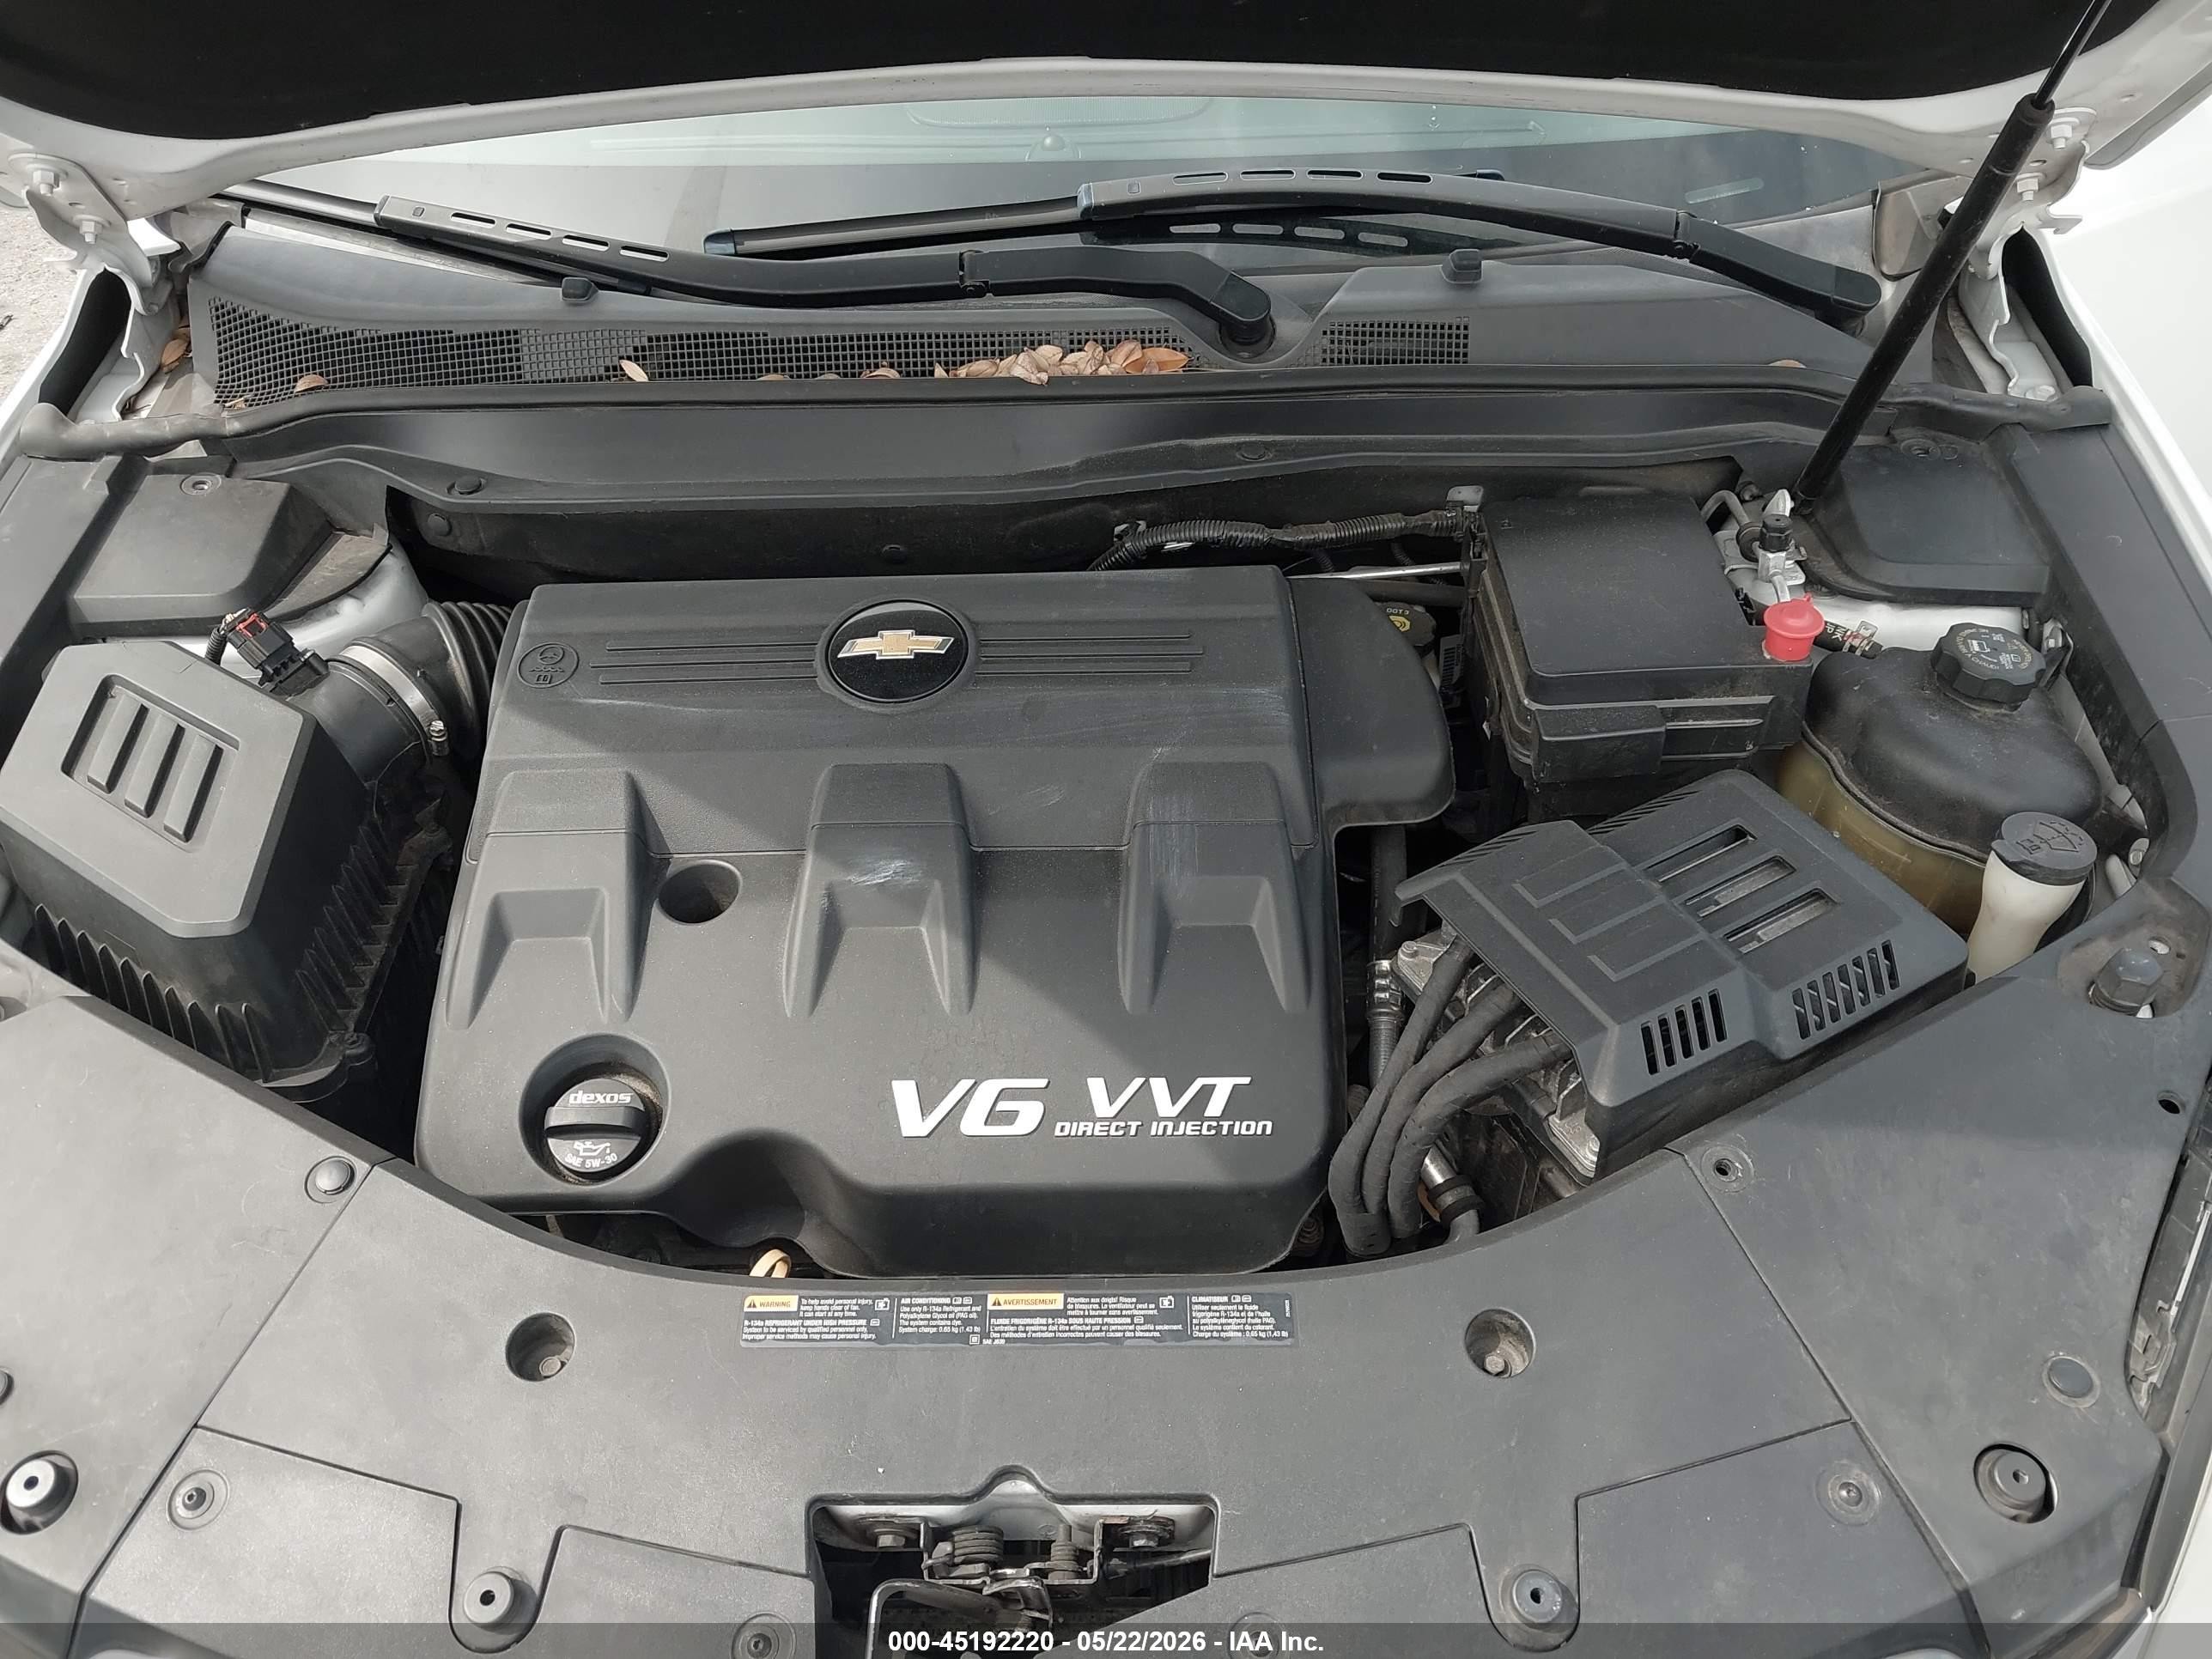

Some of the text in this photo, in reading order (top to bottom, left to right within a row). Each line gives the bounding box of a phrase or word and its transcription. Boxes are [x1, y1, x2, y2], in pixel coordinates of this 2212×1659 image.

[569, 1091, 634, 1103] dexos
[1086, 1077, 1251, 1117] VVT
[892, 1079, 1049, 1137] V6
[1054, 1121, 1273, 1137] DIRECT INJECTION
[565, 1153, 617, 1168] SAE 5W-30
